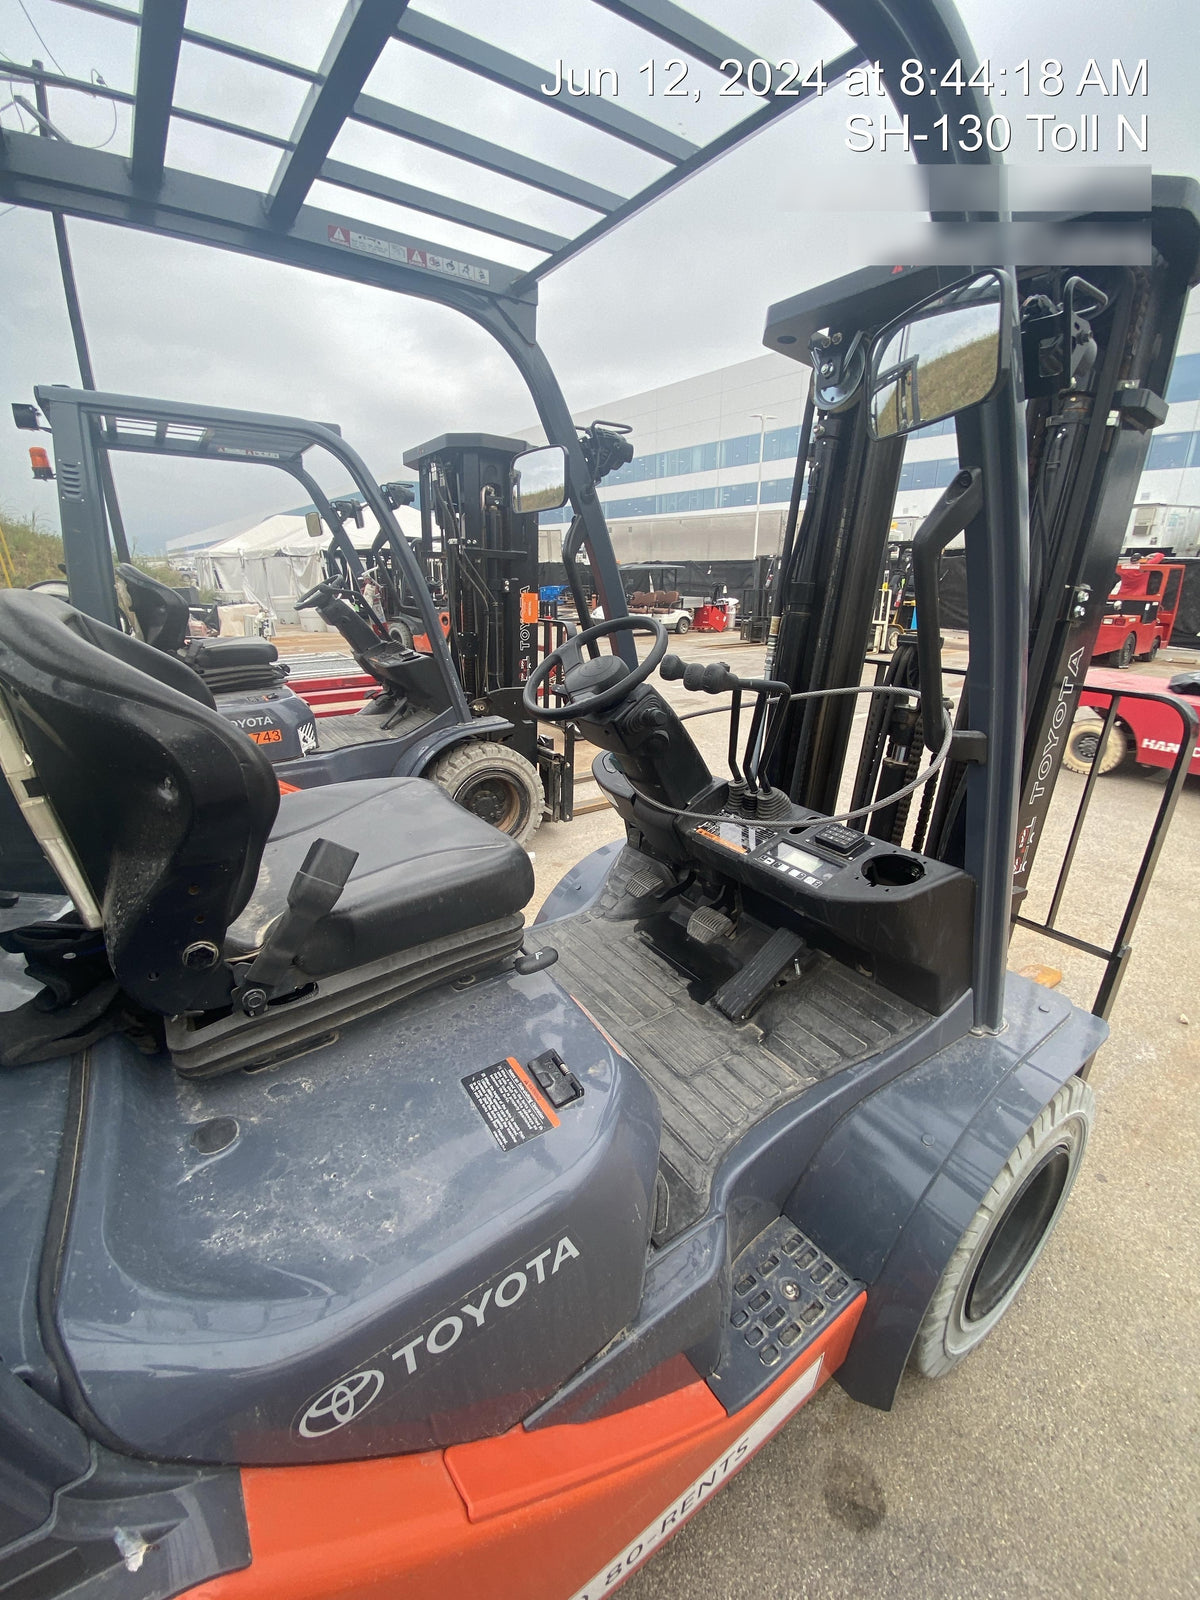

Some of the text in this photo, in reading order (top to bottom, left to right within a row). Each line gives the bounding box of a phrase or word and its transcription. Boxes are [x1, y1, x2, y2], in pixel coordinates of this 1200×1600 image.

[231, 716, 274, 728] OYOTA
[253, 730, 281, 744] 743
[1029, 646, 1085, 805] TOYOTA
[392, 1236, 580, 1374] TOYOTA
